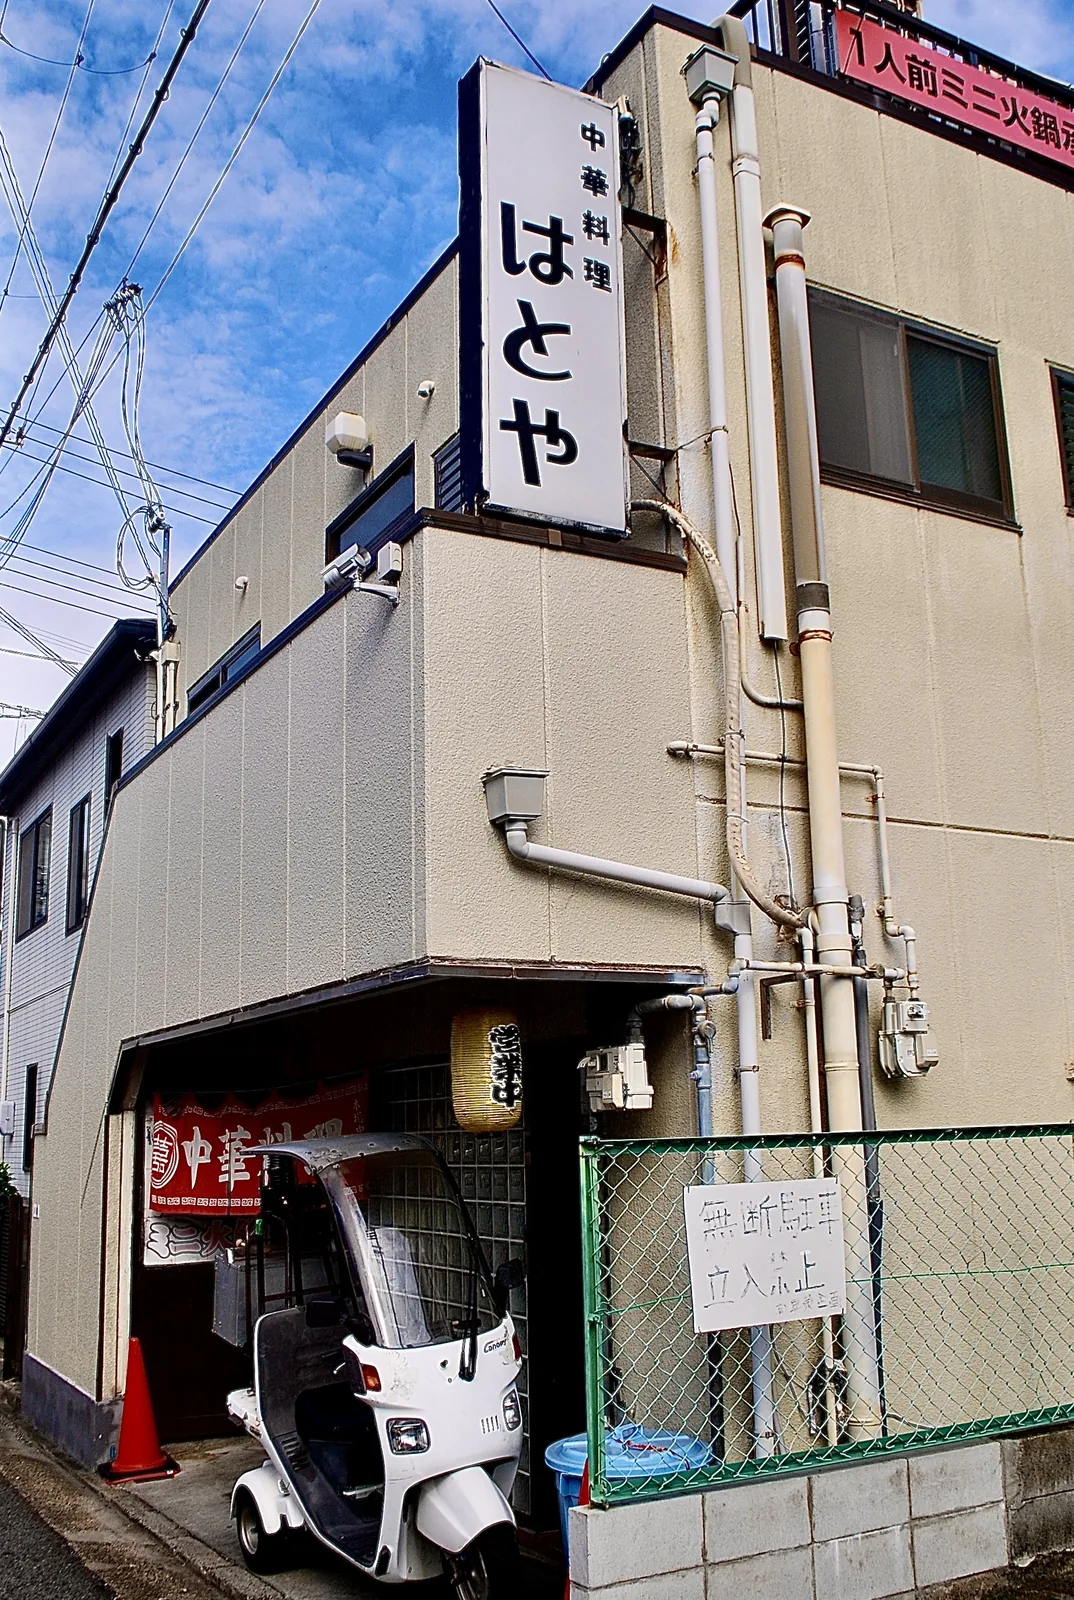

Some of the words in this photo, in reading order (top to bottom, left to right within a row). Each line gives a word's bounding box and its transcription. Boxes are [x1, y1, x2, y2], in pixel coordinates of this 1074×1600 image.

[580, 122, 612, 293] 中華料理
[499, 201, 578, 487] はとや
[699, 1191, 840, 1242] 無断駐車
[703, 1251, 825, 1309] 立入禁止
